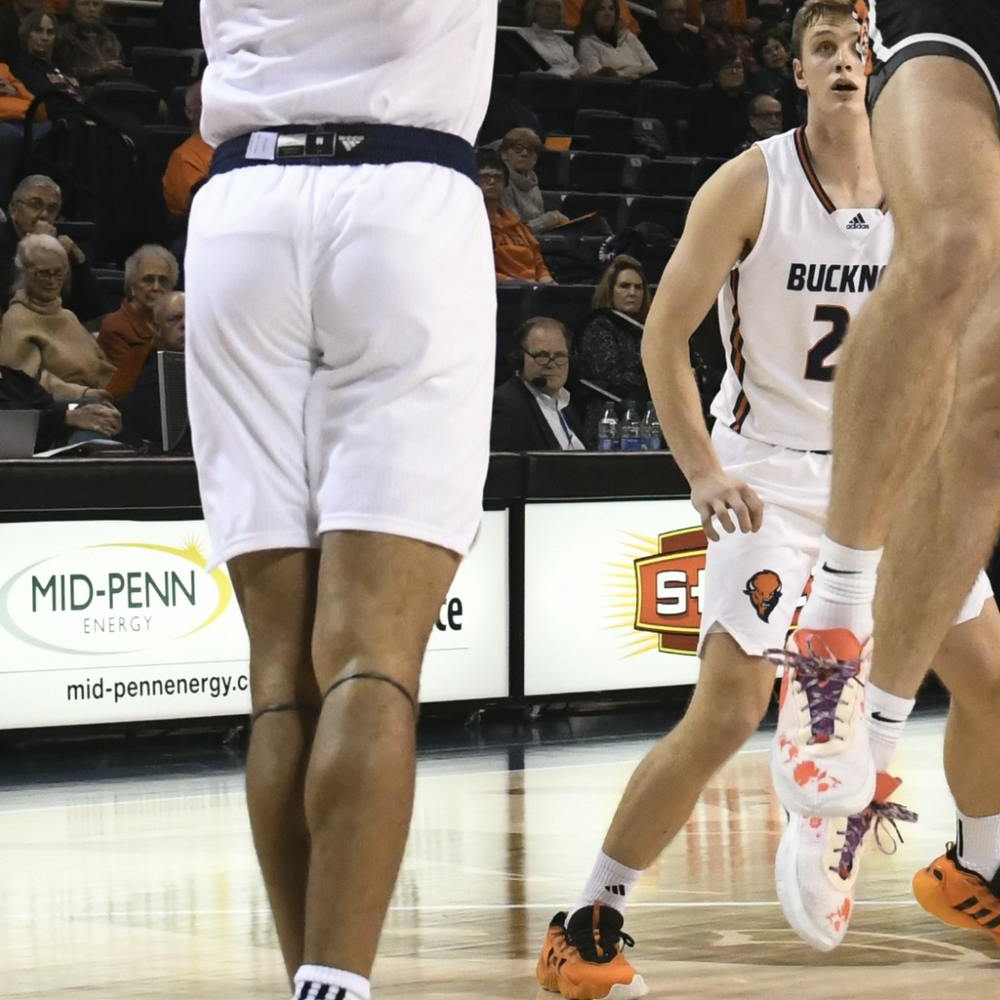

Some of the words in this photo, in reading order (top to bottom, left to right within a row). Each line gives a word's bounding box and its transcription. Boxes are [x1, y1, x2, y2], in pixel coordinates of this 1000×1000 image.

[786, 263, 886, 293] BUCKN
[804, 304, 850, 382] 2
[32, 570, 196, 613] MID-PENN
[83, 615, 152, 634] ENERGY
